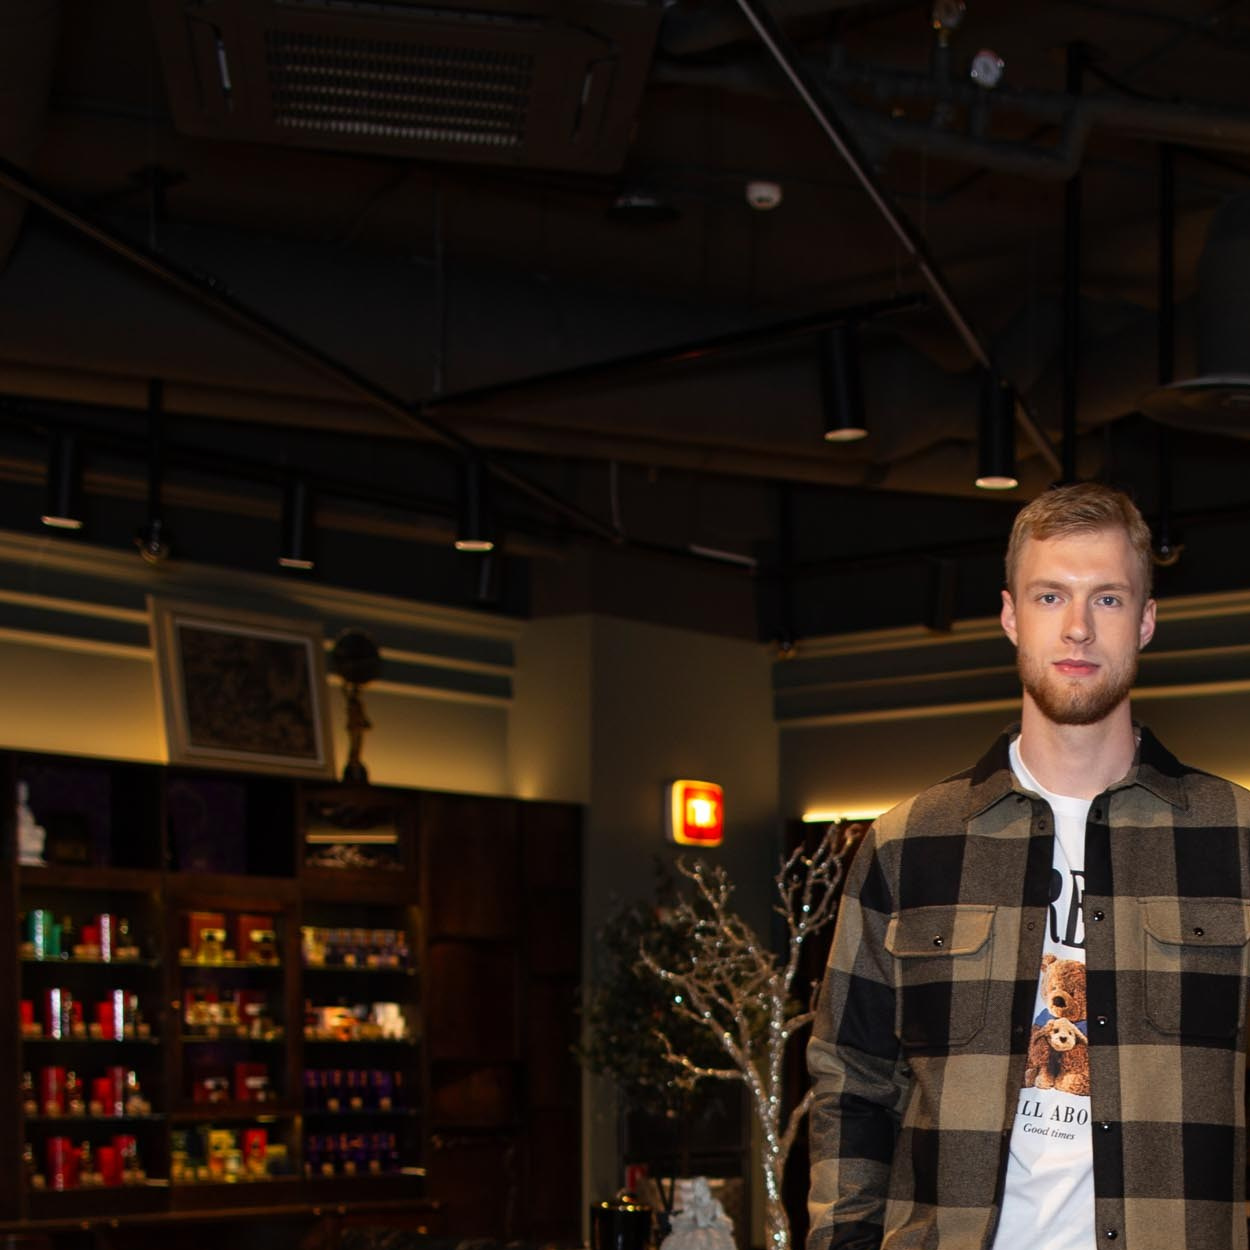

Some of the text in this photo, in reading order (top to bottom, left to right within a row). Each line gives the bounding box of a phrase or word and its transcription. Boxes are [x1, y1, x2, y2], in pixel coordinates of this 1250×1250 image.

[1016, 1101, 1088, 1125] LL ABO
[1023, 1123, 1075, 1140] Good times
